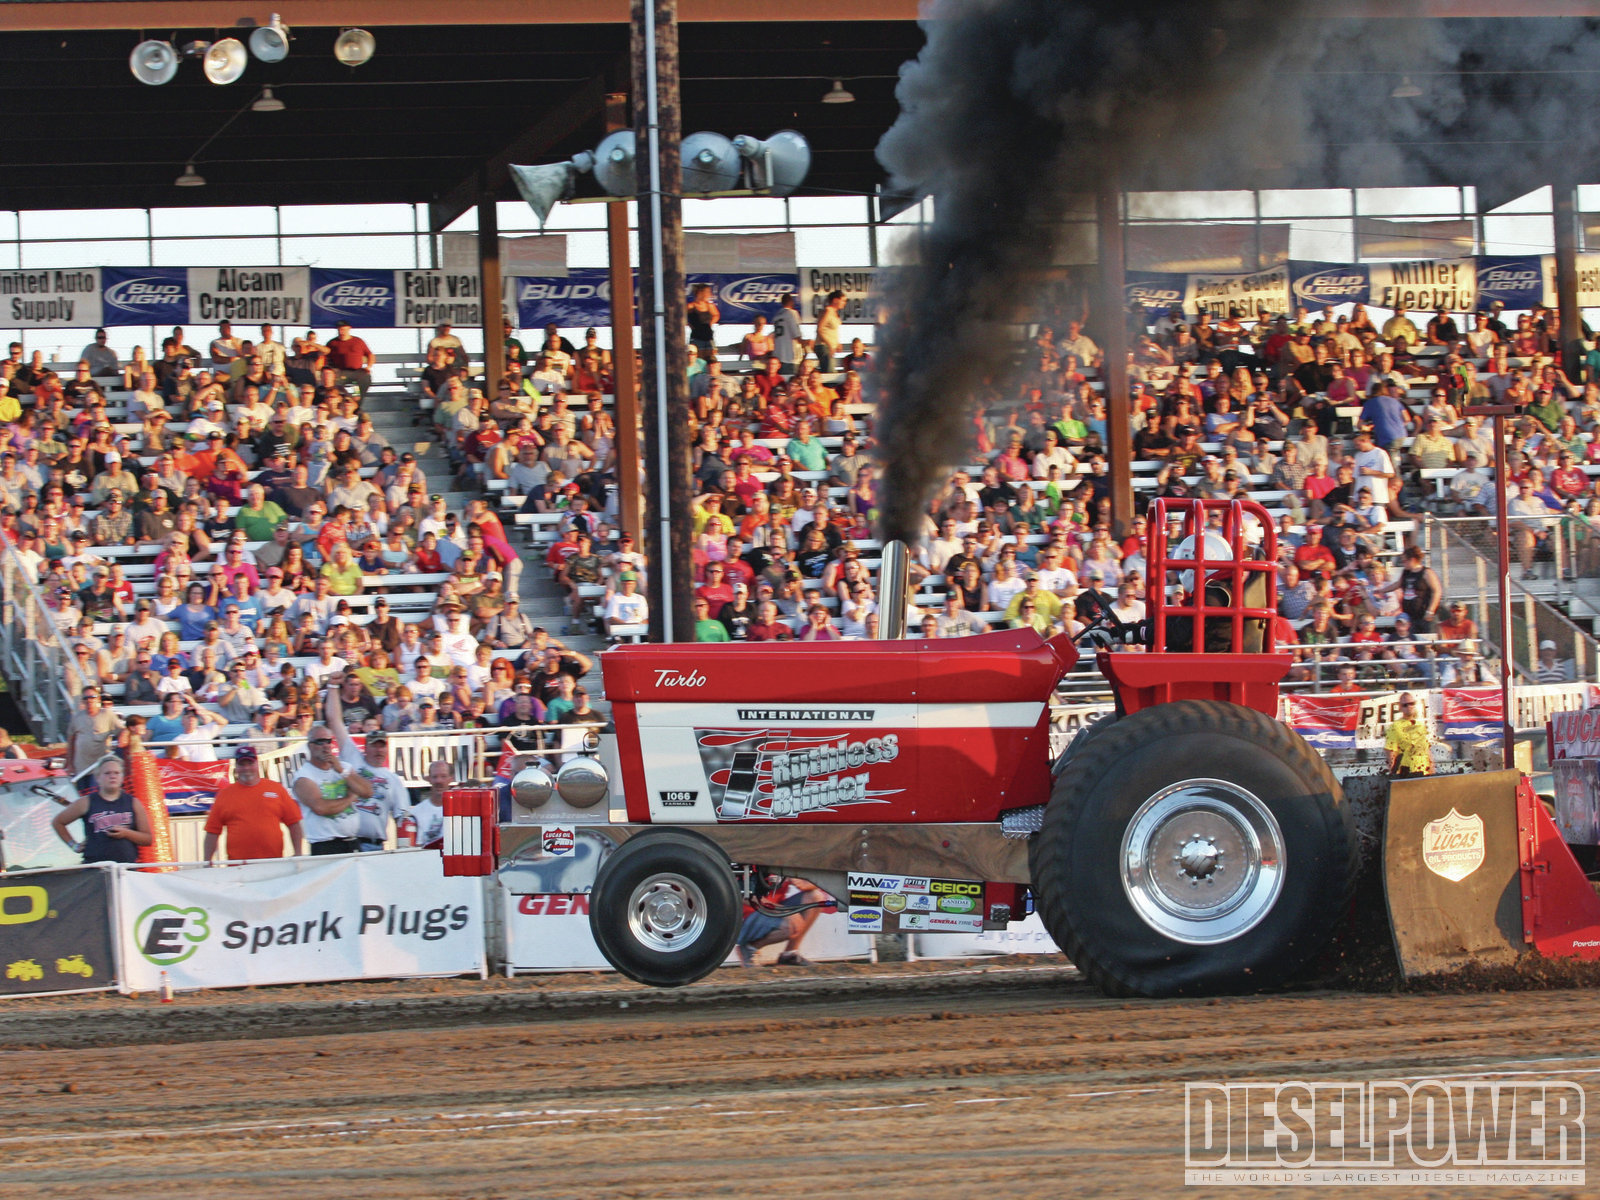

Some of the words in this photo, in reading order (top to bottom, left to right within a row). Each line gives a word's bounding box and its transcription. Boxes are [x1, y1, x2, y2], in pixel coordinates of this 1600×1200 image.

[0, 272, 48, 294] nited
[55, 271, 94, 293] Auto
[217, 268, 283, 292] Alcam
[1390, 261, 1460, 285] Miller
[405, 271, 440, 297] Fair
[1302, 285, 1368, 295] LIGHT
[1479, 280, 1542, 290] LIGHT
[117, 294, 186, 304] LIGHT
[200, 292, 303, 322] Creamery
[324, 296, 393, 307] LIGHT
[730, 292, 798, 303] LIGH
[1382, 286, 1471, 310] Electric
[12, 297, 74, 321] Supply
[654, 669, 707, 688] Turbo
[741, 710, 872, 720] INTERNATIONAL
[667, 792, 691, 801] 1066
[772, 771, 870, 818] Binder
[1431, 832, 1479, 851] LUCAS
[930, 882, 982, 895] GEICO
[222, 911, 343, 954] Spark
[359, 904, 470, 941] Plugs
